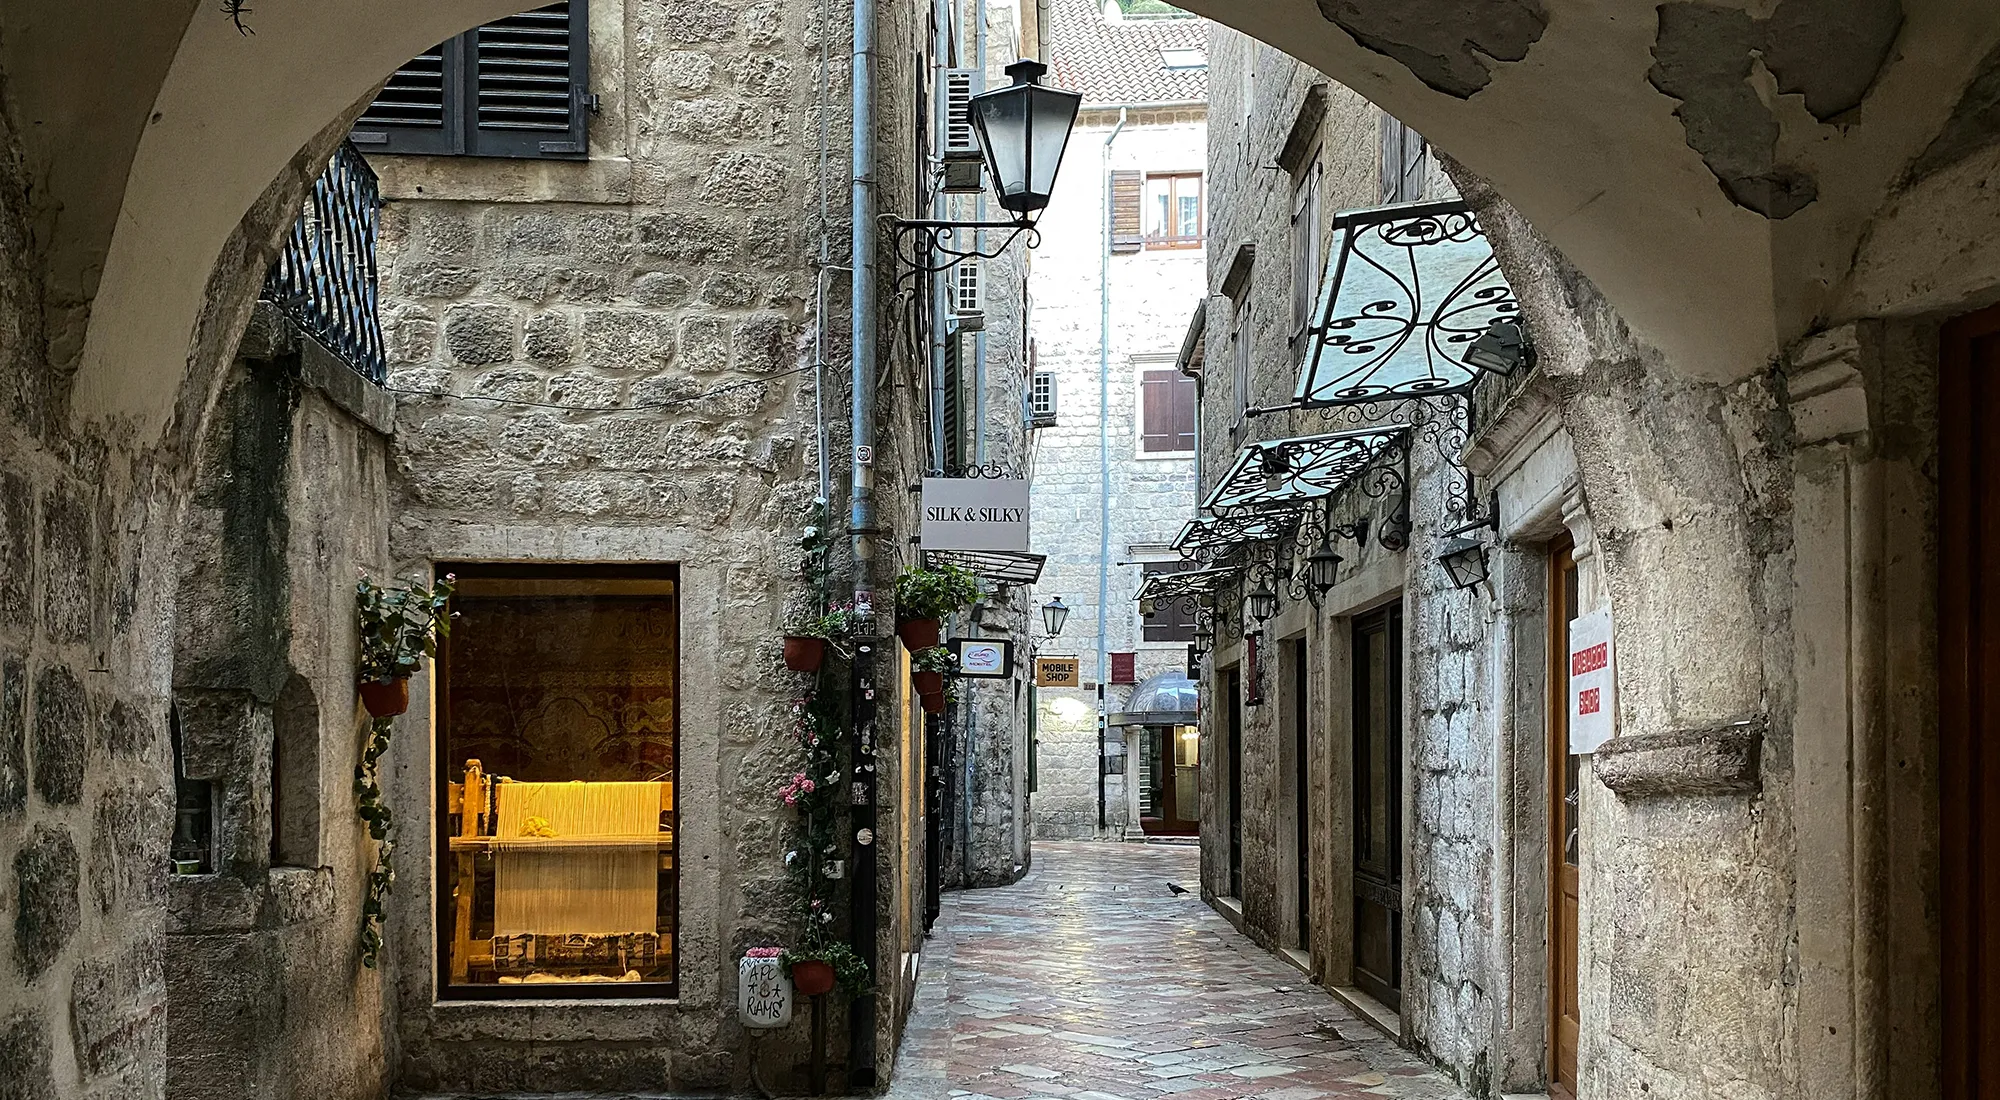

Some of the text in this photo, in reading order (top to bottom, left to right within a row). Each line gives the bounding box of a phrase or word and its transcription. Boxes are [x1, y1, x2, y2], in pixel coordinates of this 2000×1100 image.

[927, 507, 1024, 523] SILK & SILKY
[1042, 663, 1073, 673] MOBILE
[1046, 673, 1070, 682] SHOP
[1579, 687, 1599, 715] SHOP
